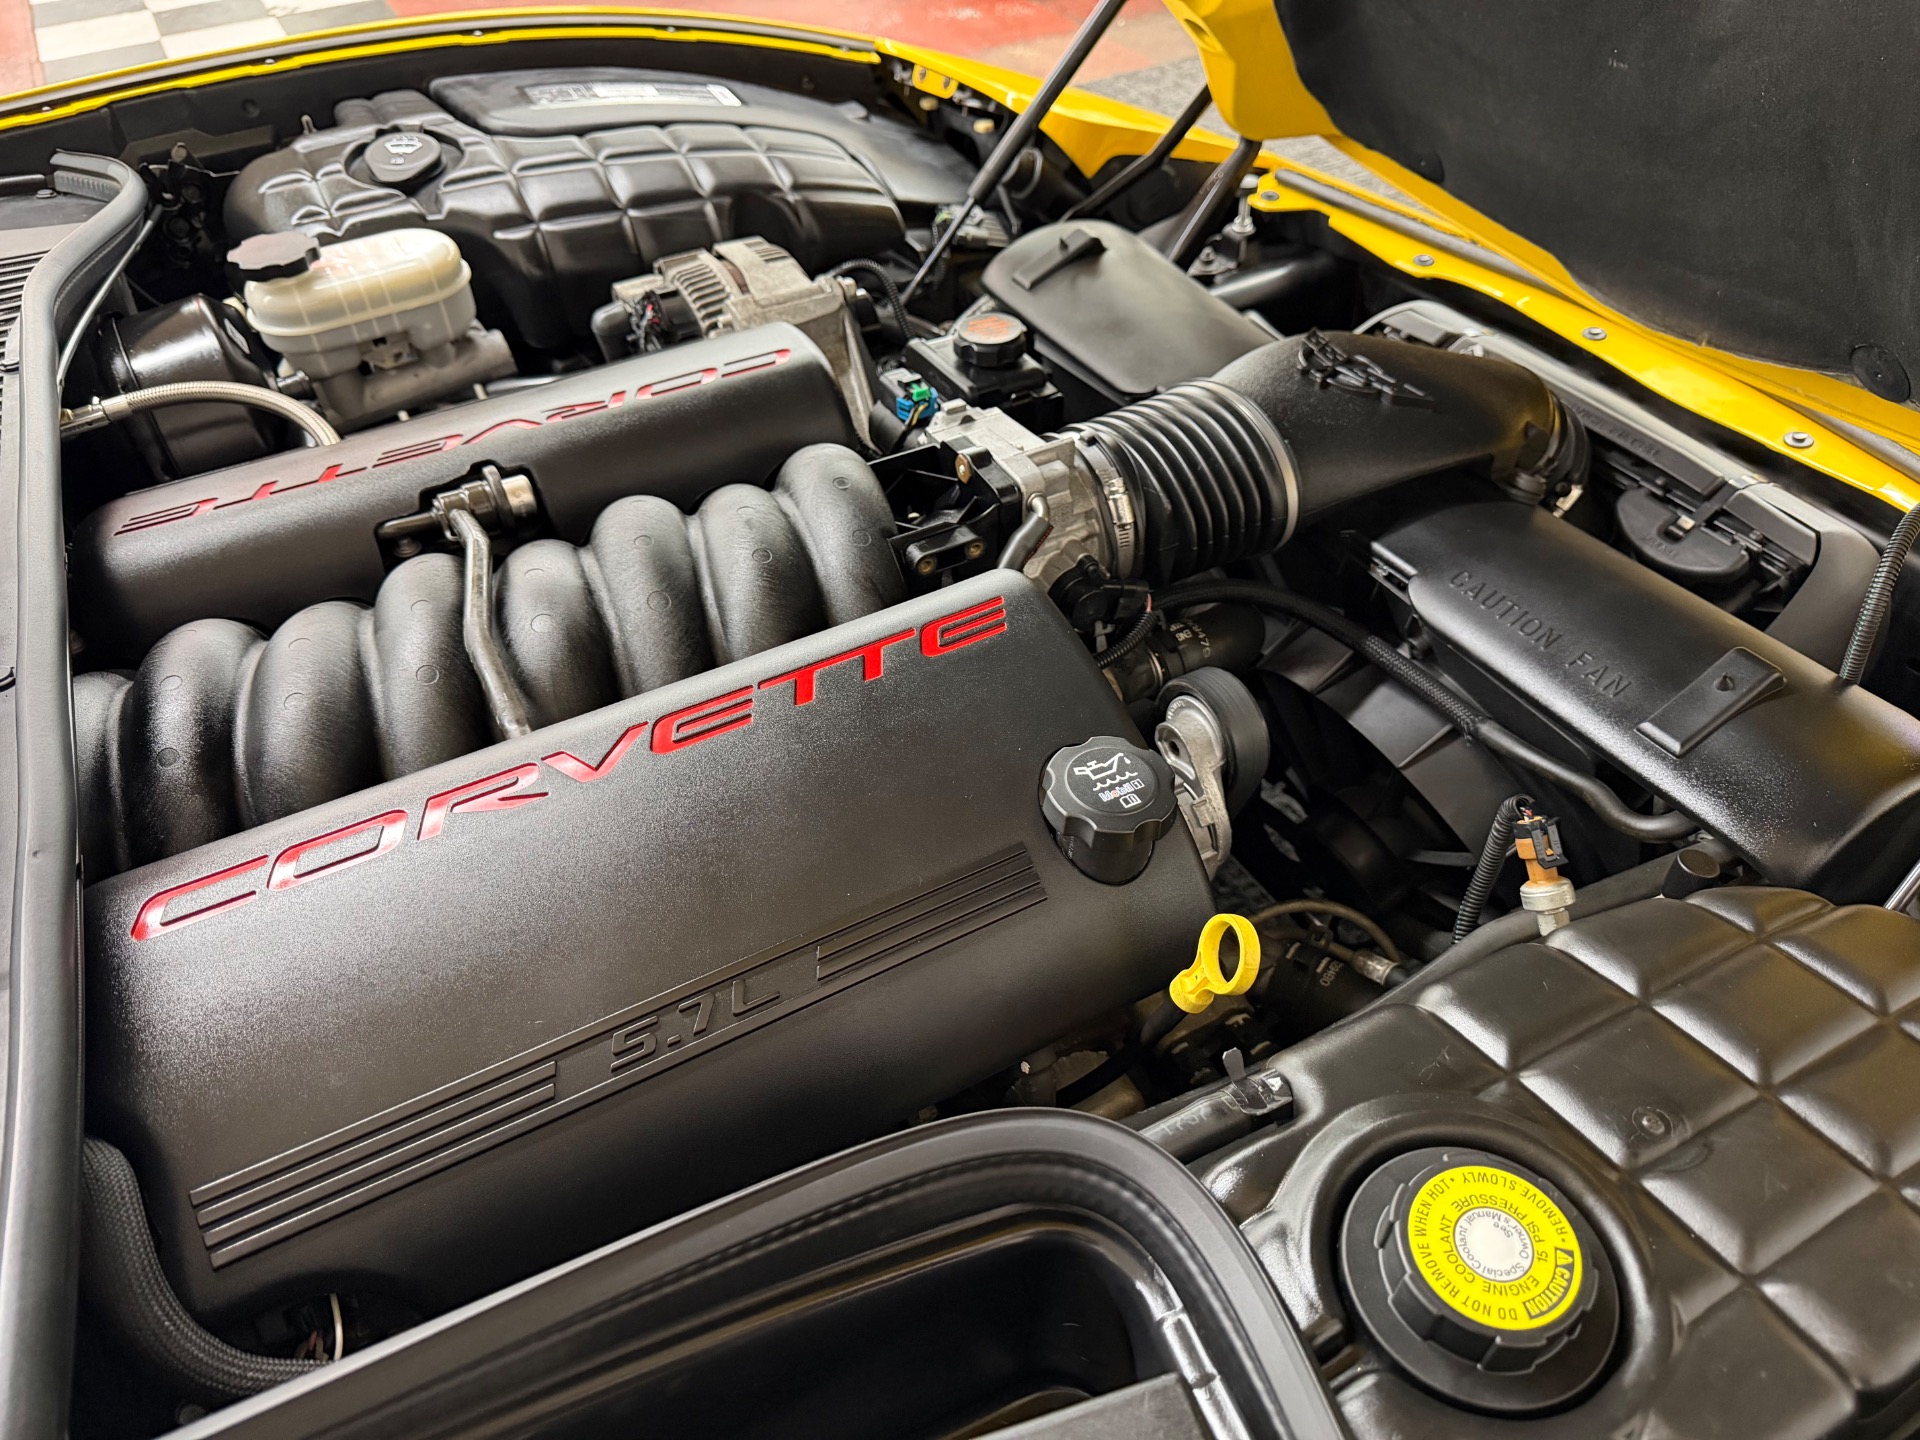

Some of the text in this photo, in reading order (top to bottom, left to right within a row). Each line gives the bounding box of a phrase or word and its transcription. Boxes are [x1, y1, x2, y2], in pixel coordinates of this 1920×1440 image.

[113, 348, 791, 536] CORVETTE
[1449, 570, 1632, 699] CAUTION FAN
[131, 596, 1007, 942] CORVETTE
[1098, 782, 1135, 802] Mobil
[610, 978, 781, 1073] 5.7L
[1462, 1172, 1517, 1191] SLOWLY
[1414, 1178, 1518, 1320] DO NOT REMOVE WHEN HOT
[1439, 1214, 1540, 1296] ENGINE COOLANT
[1450, 1193, 1549, 1263] 15 PSI PRESSURE
[1457, 1225, 1526, 1279] Special Coolant
[1464, 1210, 1531, 1260] Owner's Manual
[1492, 1221, 1514, 1239] See
[1525, 1267, 1571, 1317] CAUTION
